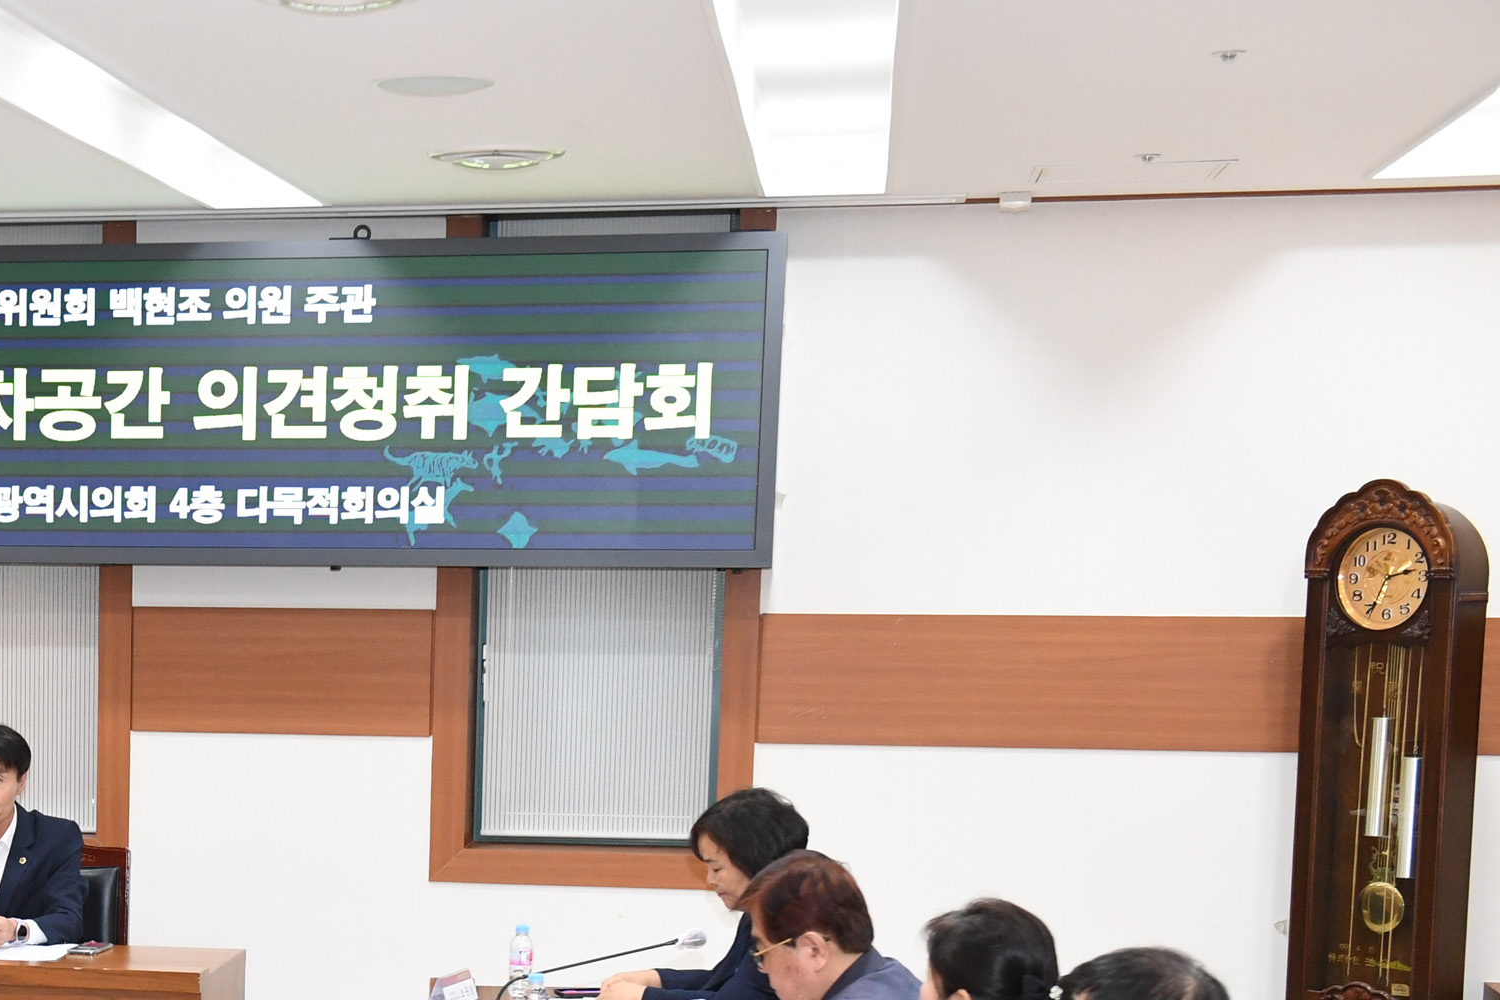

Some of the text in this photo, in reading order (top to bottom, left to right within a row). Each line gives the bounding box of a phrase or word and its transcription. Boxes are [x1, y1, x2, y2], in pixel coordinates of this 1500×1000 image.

[109, 286, 213, 326] 백현조
[222, 284, 293, 325] 의원
[303, 283, 377, 325] 주관
[192, 364, 470, 442] 의견청취
[499, 361, 714, 440] 간담회
[169, 485, 226, 525] 4층
[236, 485, 446, 525] 다목적회의실
[1382, 533, 1397, 545] 12
[1406, 538, 1411, 550] 1
[1366, 541, 1377, 552] 11
[1354, 555, 1366, 567] 10
[1415, 552, 1424, 563] 2
[1349, 573, 1359, 585] 9
[1418, 570, 1428, 582] 3
[1352, 590, 1363, 602] 8
[1411, 588, 1421, 599] 4
[1381, 608, 1393, 620] 6
[1399, 603, 1410, 615] 5
